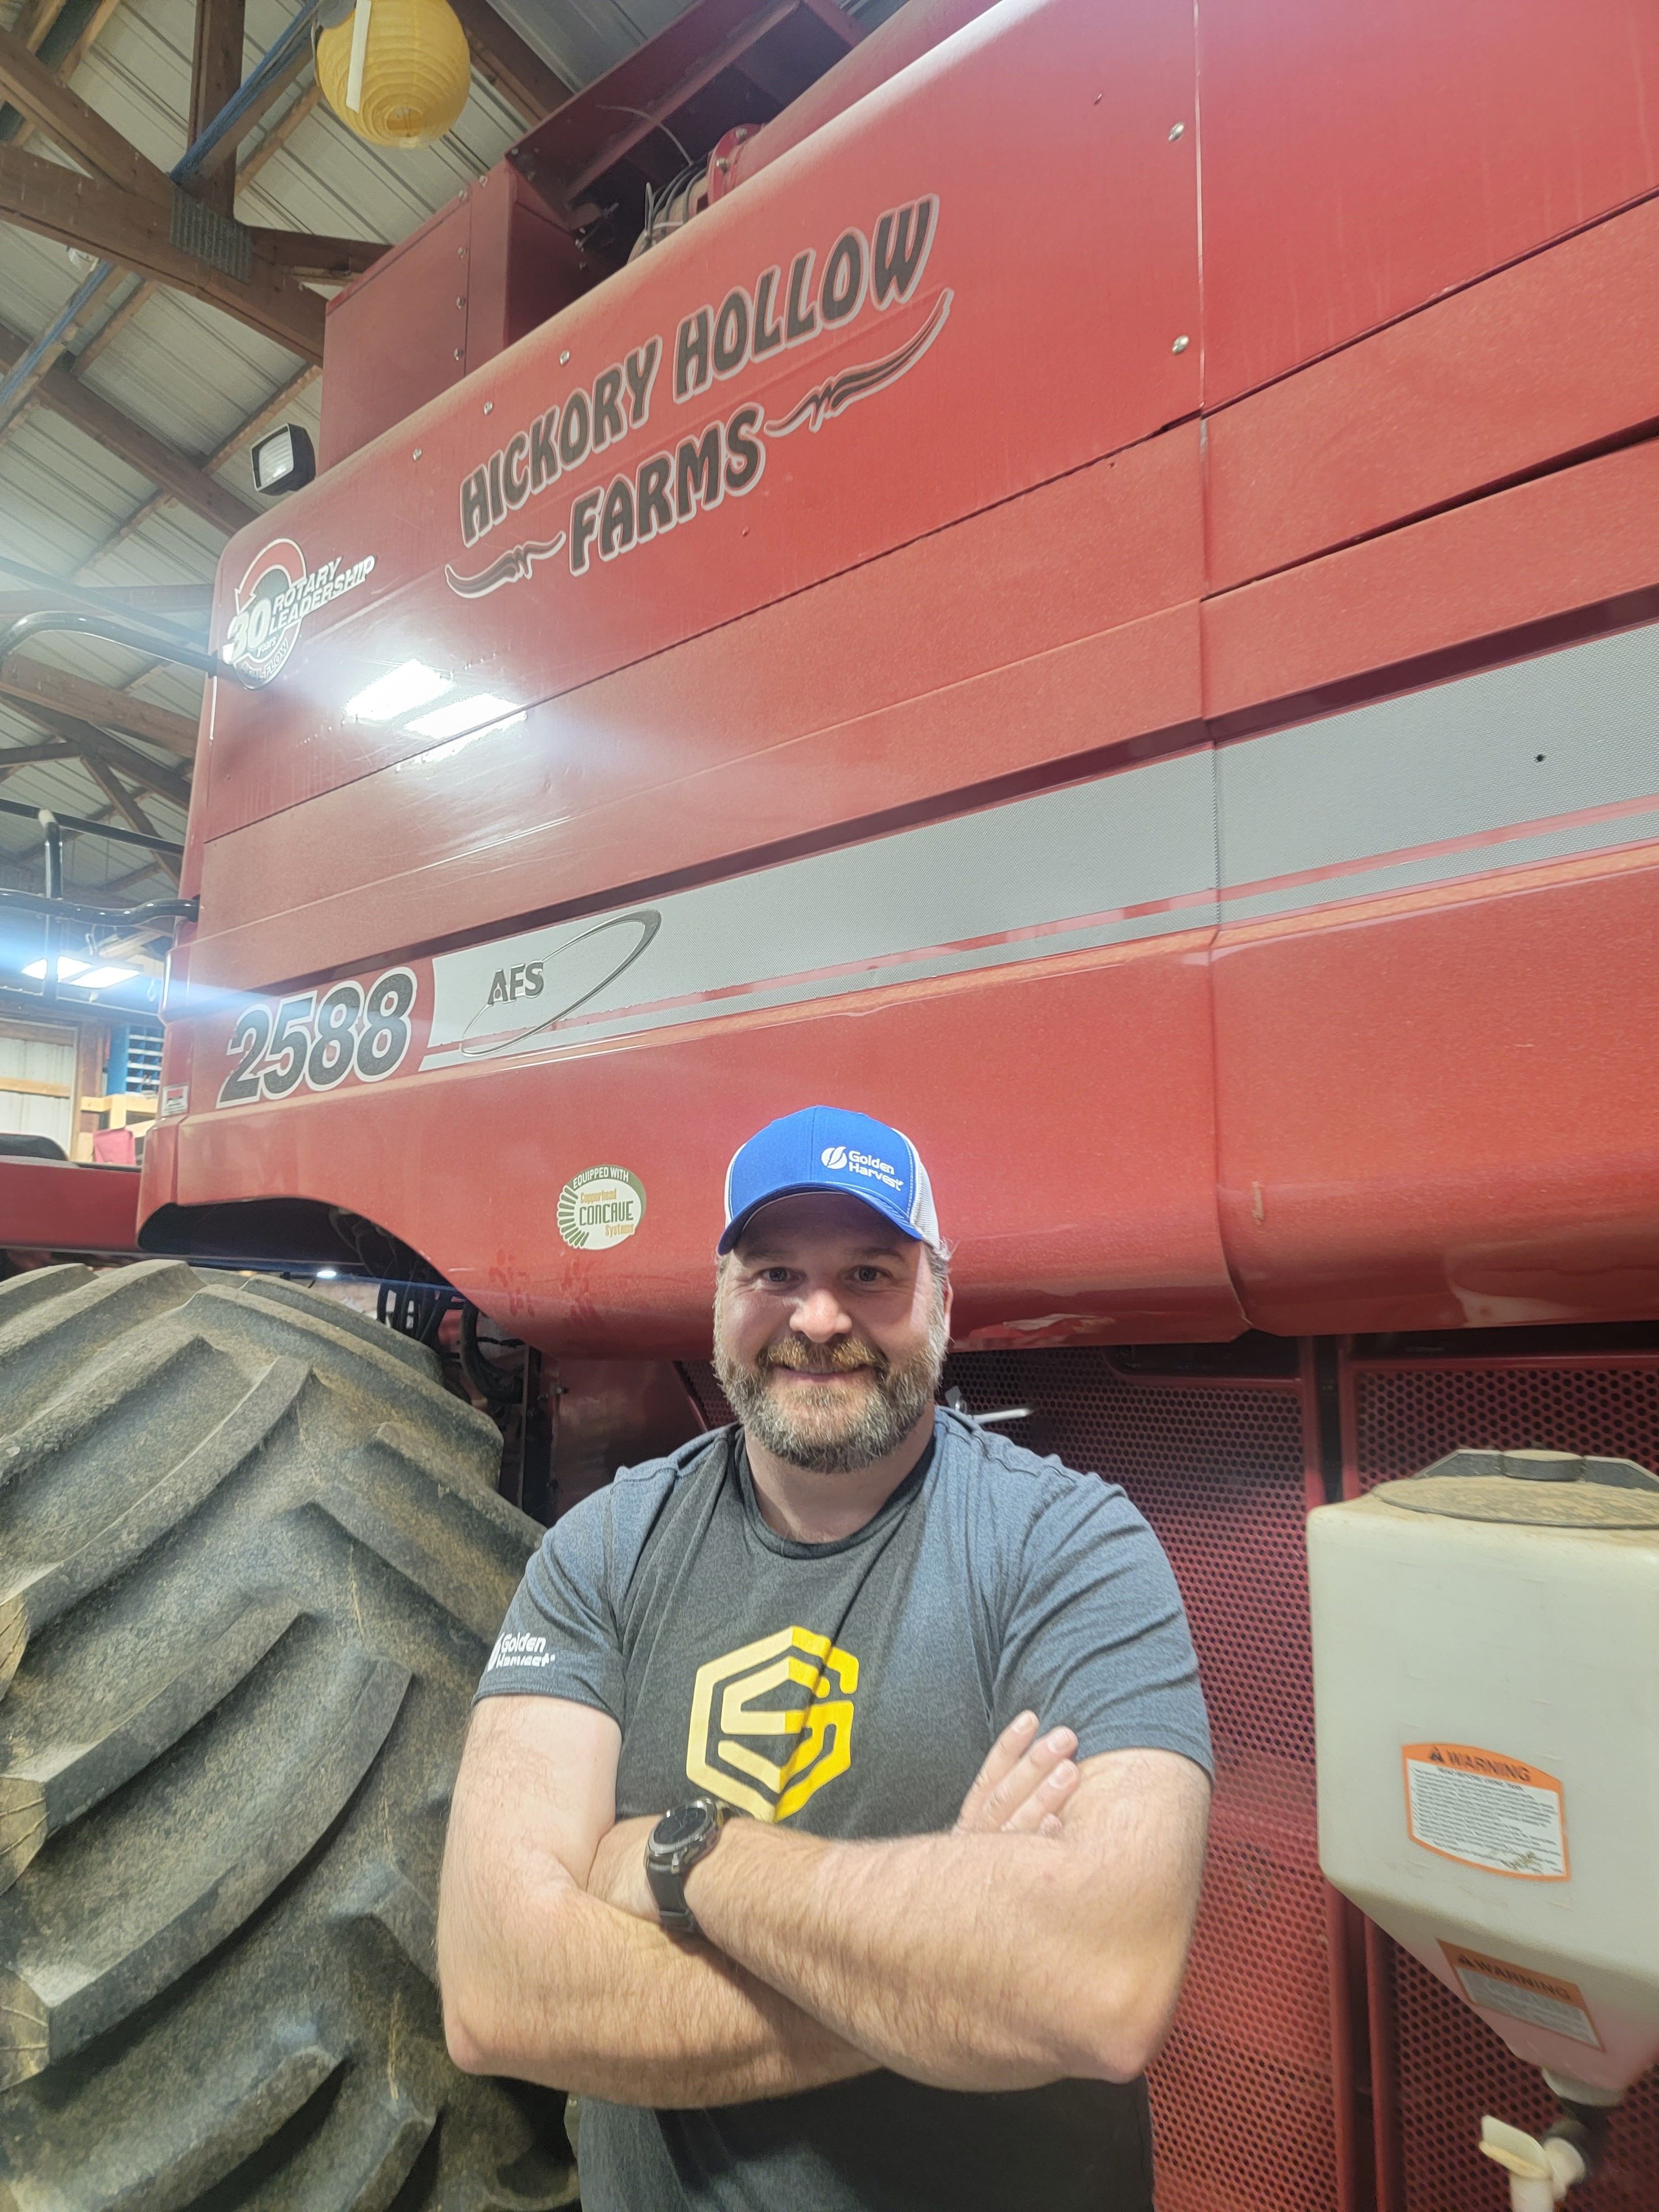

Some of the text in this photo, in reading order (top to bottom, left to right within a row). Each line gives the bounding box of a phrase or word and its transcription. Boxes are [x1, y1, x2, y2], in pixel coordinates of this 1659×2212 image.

[460, 193, 938, 548] HICKORY HOLLOW
[570, 403, 766, 576] FARMS
[269, 555, 375, 636] LEADERSHIP
[273, 556, 342, 614] ROTARY
[224, 598, 272, 664] 30
[257, 637, 277, 658] years
[486, 960, 544, 1006] AFS
[216, 966, 417, 1108] 2588
[573, 1167, 629, 1190] EQUIPPED WITH
[848, 1150, 895, 1175] Golden
[849, 1162, 904, 1192] Harvest
[580, 1201, 634, 1226] CONCAVE
[605, 1224, 634, 1238] Systems
[501, 1632, 546, 1653] Golden
[1446, 1749, 1532, 1782] WARNING
